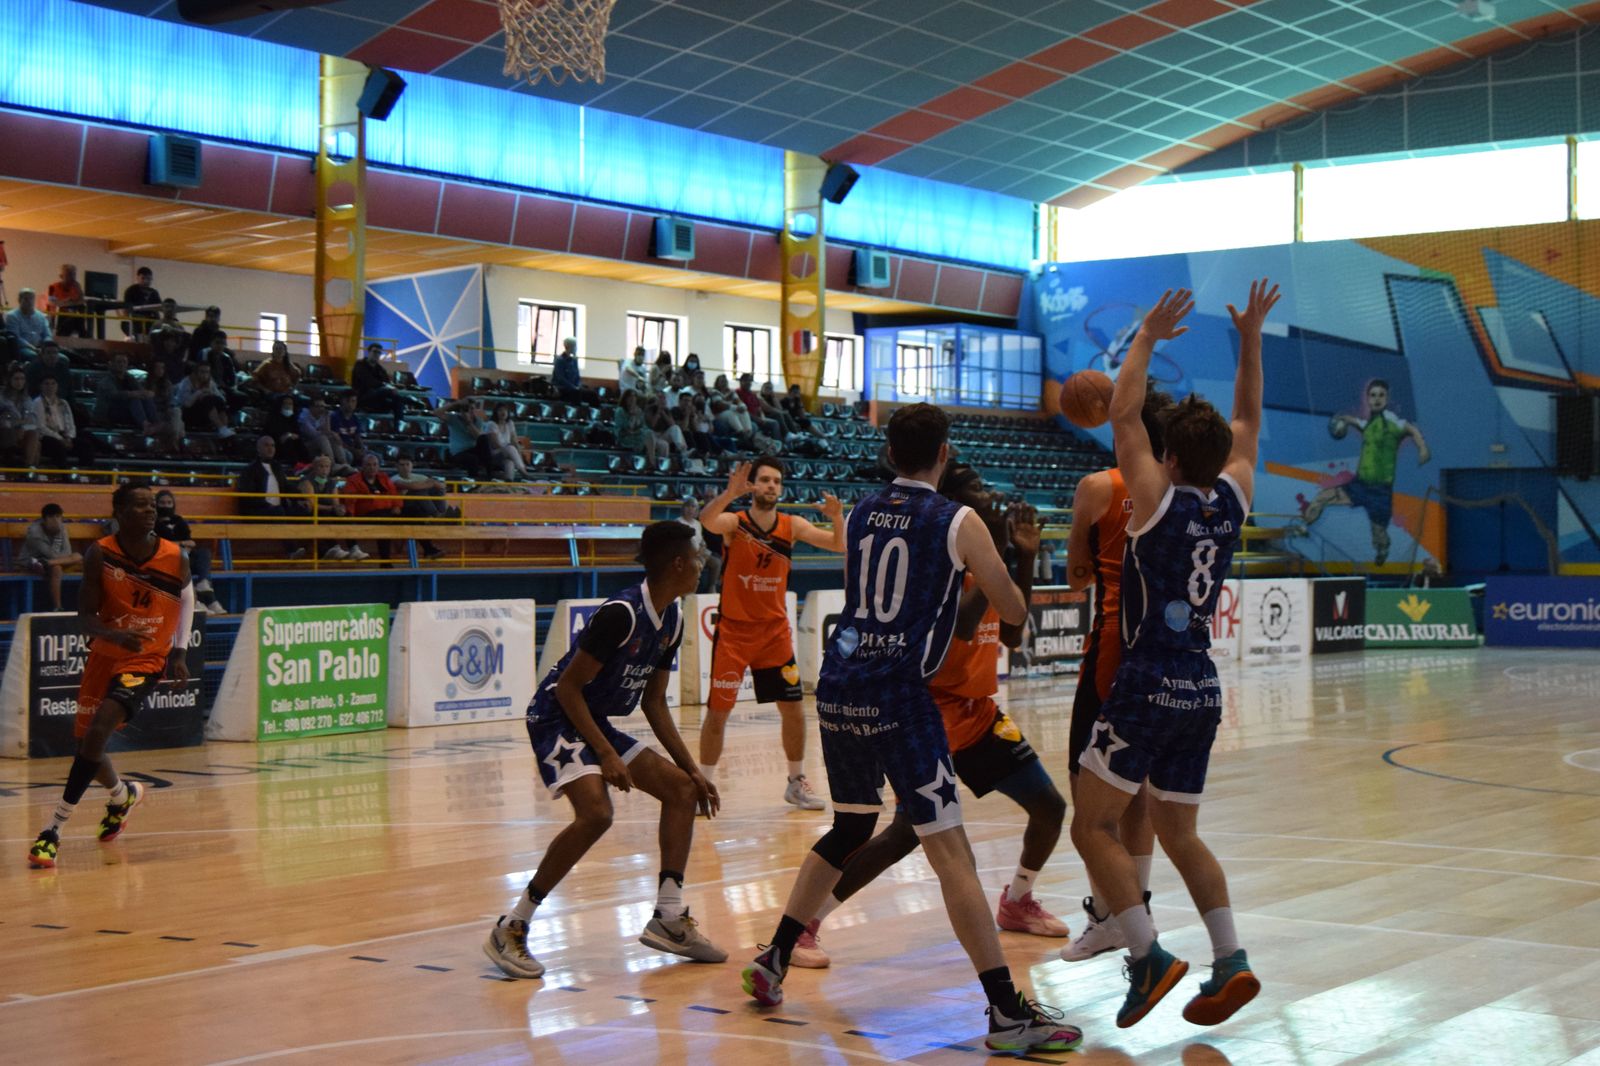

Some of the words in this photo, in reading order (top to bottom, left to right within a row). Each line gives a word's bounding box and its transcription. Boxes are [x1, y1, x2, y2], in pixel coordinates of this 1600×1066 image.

[867, 512, 911, 530] FORTU
[854, 533, 910, 623] 10
[1187, 539, 1218, 606] 8
[131, 590, 152, 608] 14
[1041, 608, 1079, 630] ANTONIO
[262, 612, 384, 651] Supermercados
[860, 632, 907, 647] PIXEL
[1315, 625, 1364, 641] VALCARCE
[1365, 624, 1409, 641] CAJA
[1409, 624, 1476, 641] RURAL
[266, 652, 311, 686] San
[318, 647, 380, 681] Pablo
[446, 643, 504, 677] C&M
[1148, 693, 1191, 710] Villares
